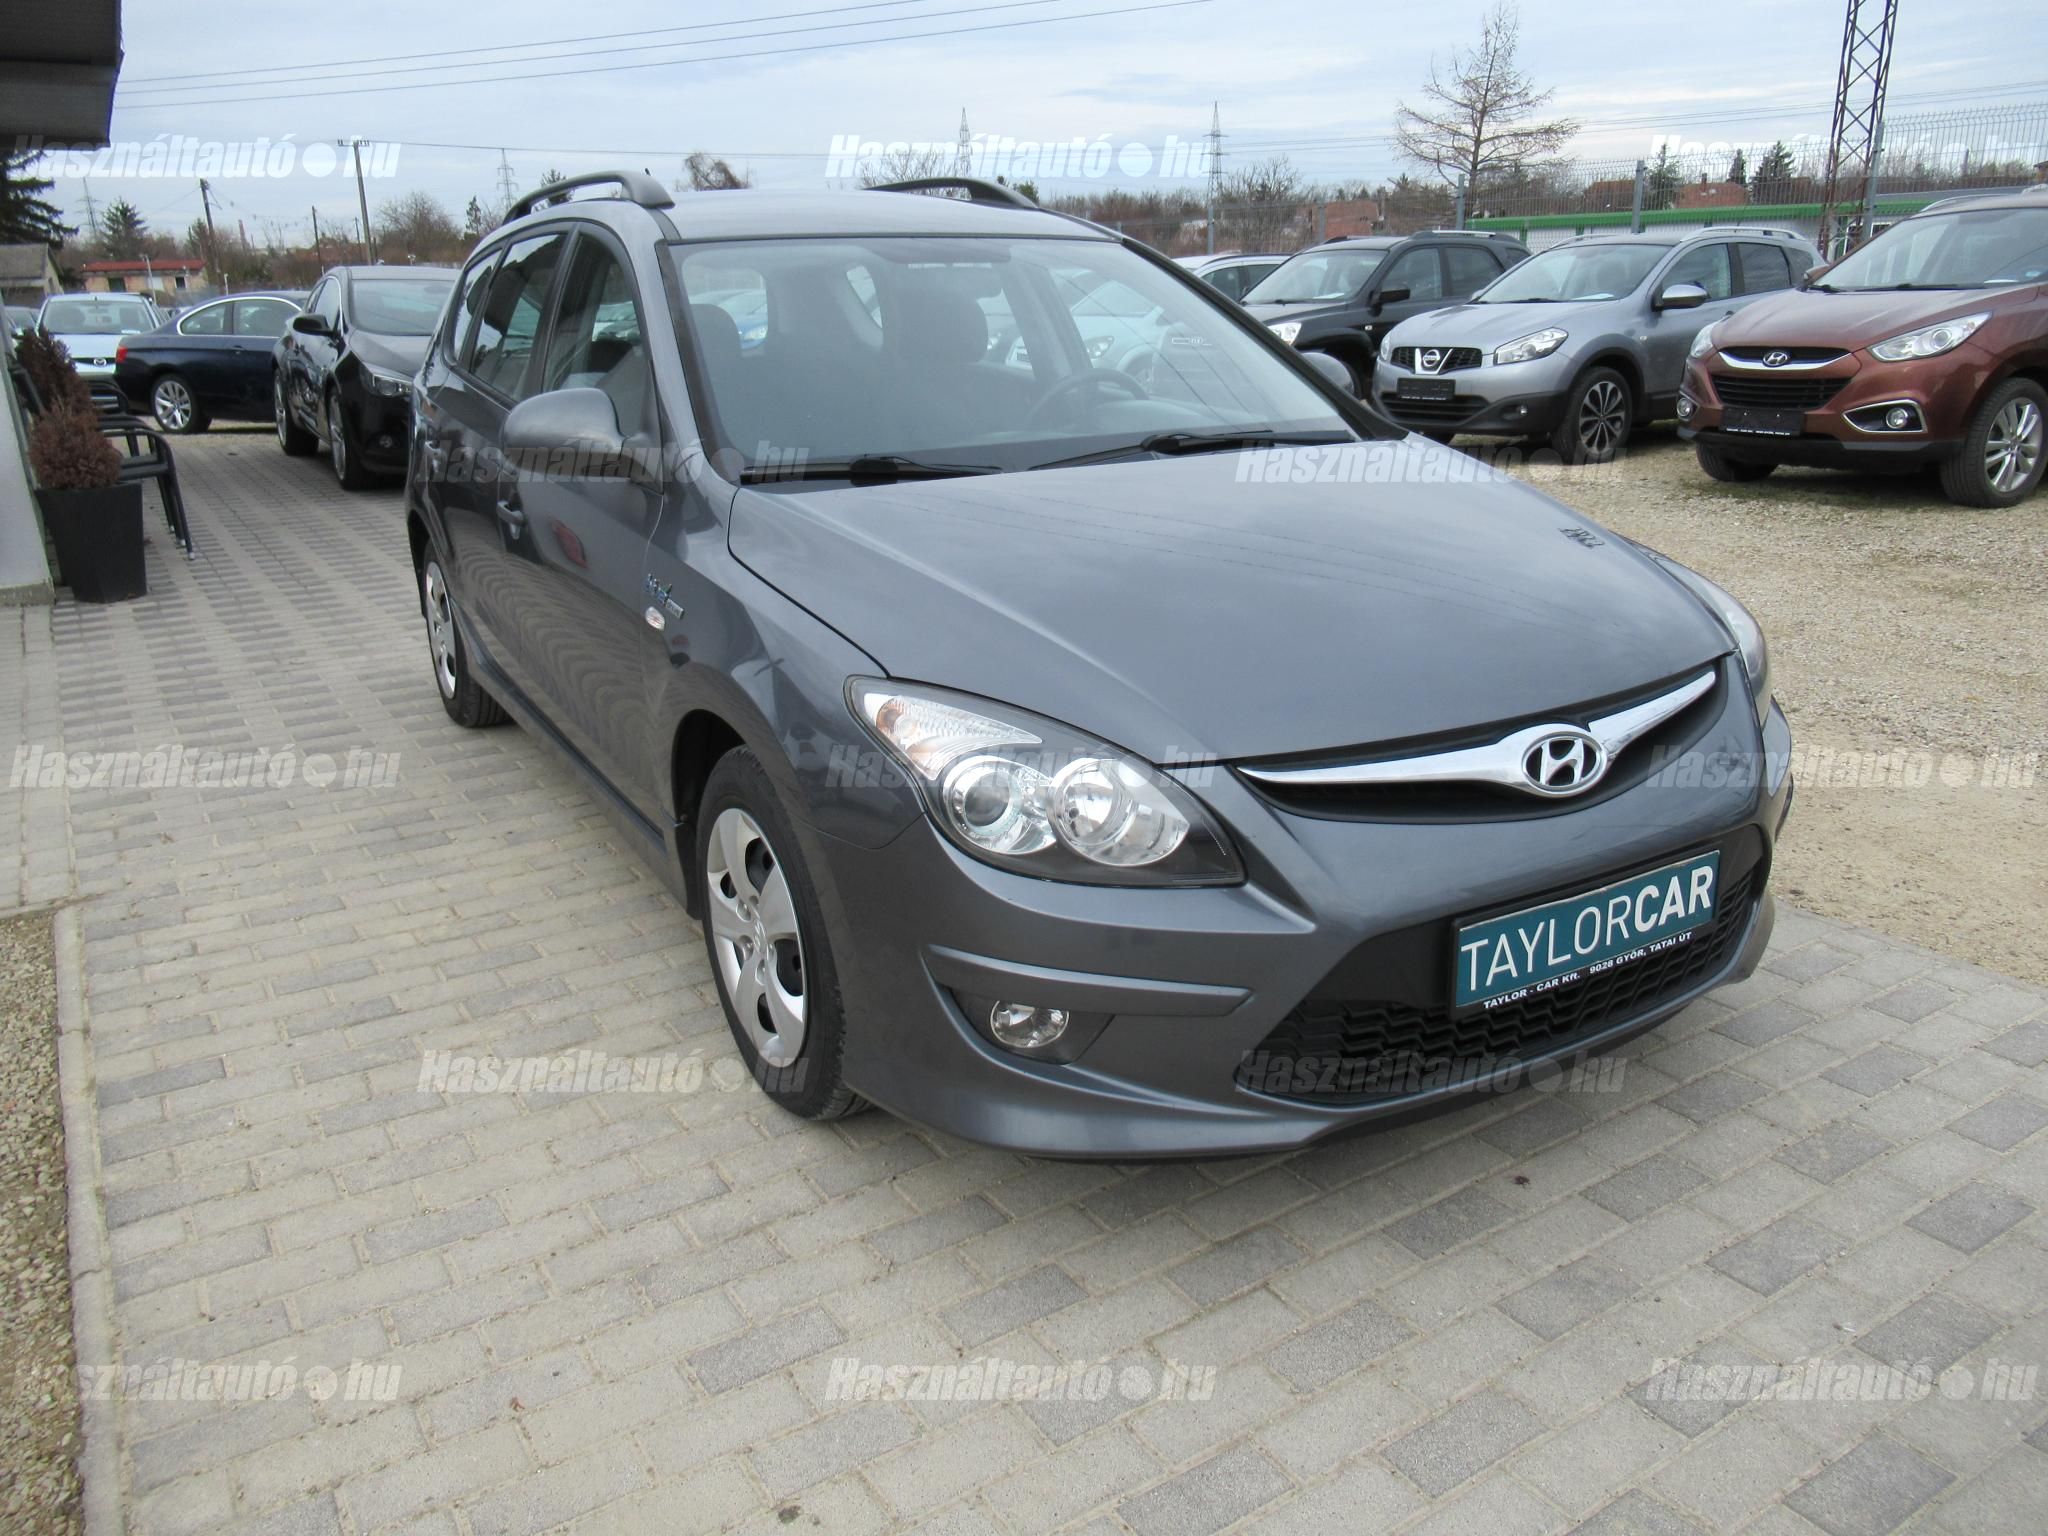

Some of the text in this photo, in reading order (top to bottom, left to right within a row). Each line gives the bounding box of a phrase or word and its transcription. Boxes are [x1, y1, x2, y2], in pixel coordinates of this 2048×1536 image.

[1461, 866, 1713, 991] TAYLORCAR
[1483, 988, 1527, 1009] TAYLOR
[1536, 978, 1559, 992] CAR
[1562, 971, 1580, 984] Kft.
[1589, 959, 1614, 974] 9028
[1649, 937, 1676, 952] TATAI
